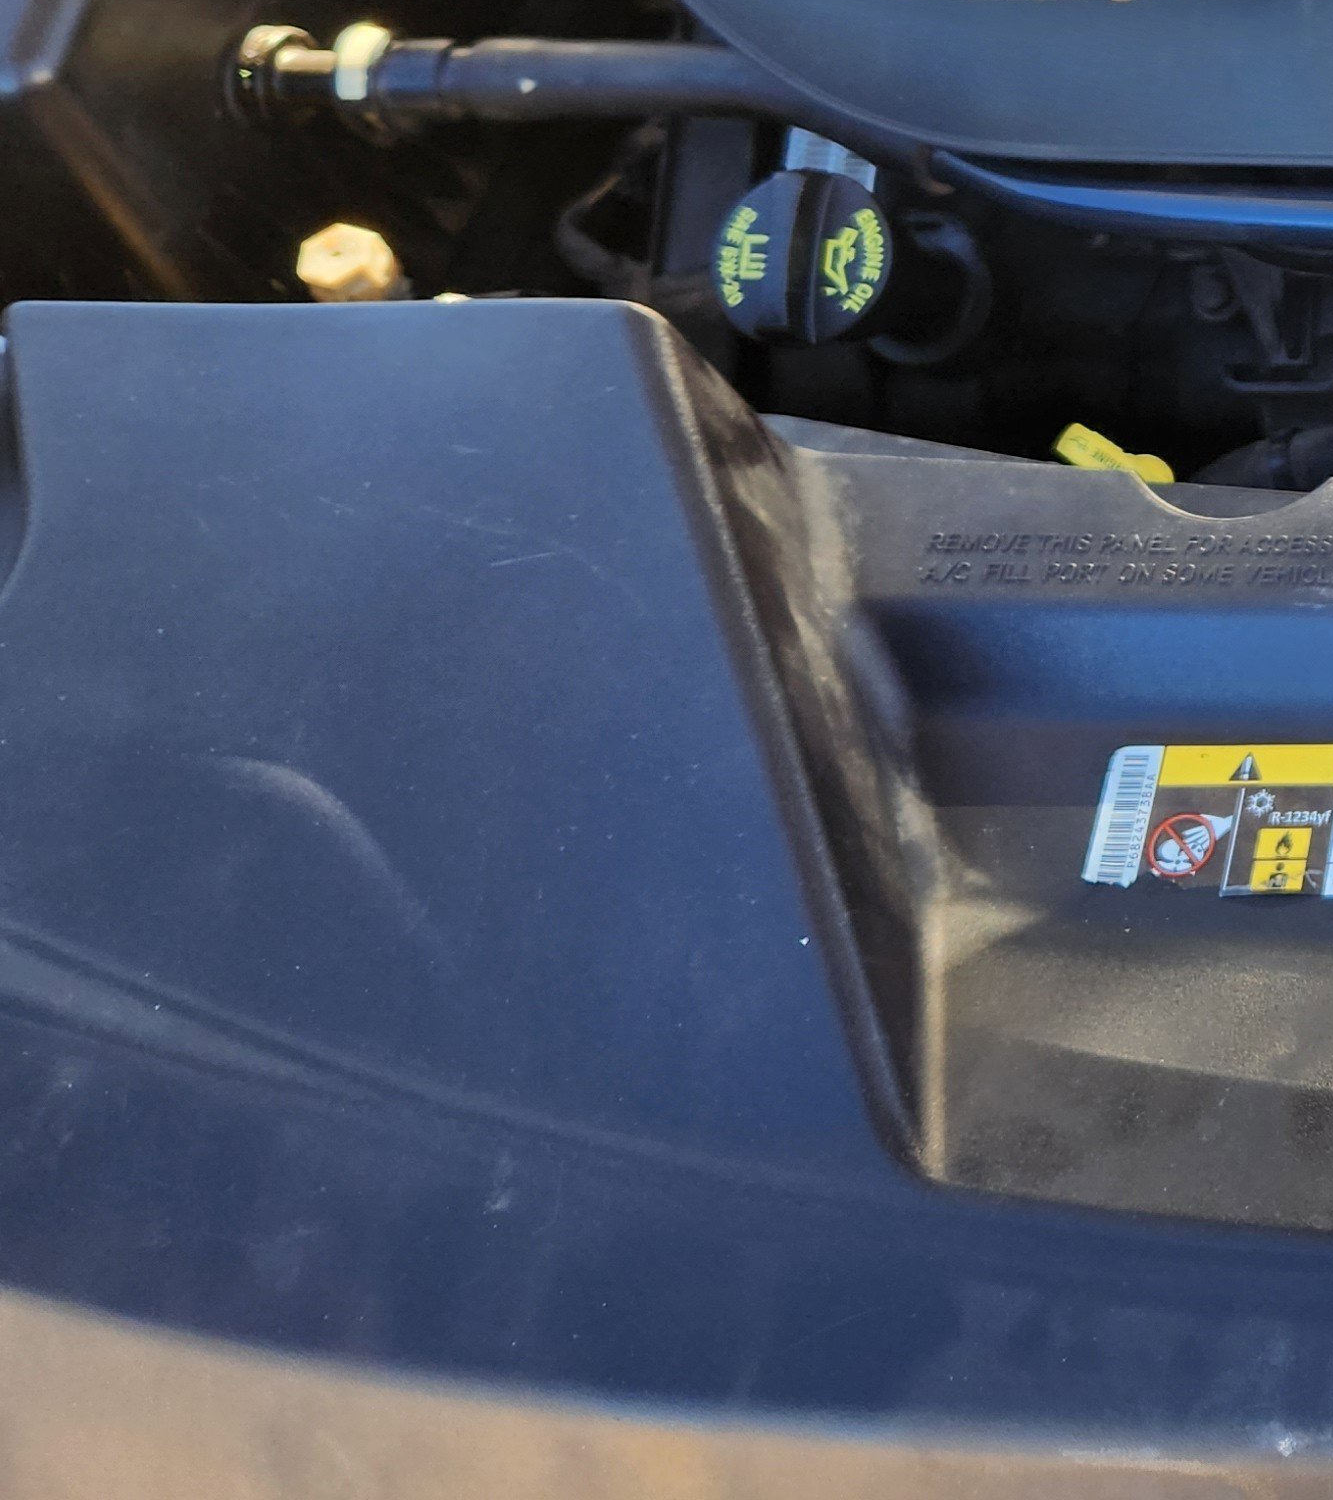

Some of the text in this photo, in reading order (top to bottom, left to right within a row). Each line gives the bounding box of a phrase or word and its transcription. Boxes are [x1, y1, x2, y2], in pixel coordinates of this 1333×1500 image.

[840, 209, 884, 313] ENGINE OIL
[927, 533, 1031, 554] REMOVE
[1037, 533, 1093, 553] THIS
[1101, 533, 1176, 555] PANEL
[1186, 534, 1233, 556] FOR
[1240, 534, 1333, 556] ACCESS
[919, 562, 972, 584] A/C
[984, 562, 1031, 584] FILL
[1043, 562, 1109, 584] PORT
[1117, 562, 1155, 584] ON
[1162, 563, 1234, 585] SOME
[1268, 809, 1332, 827] R-1234yf
